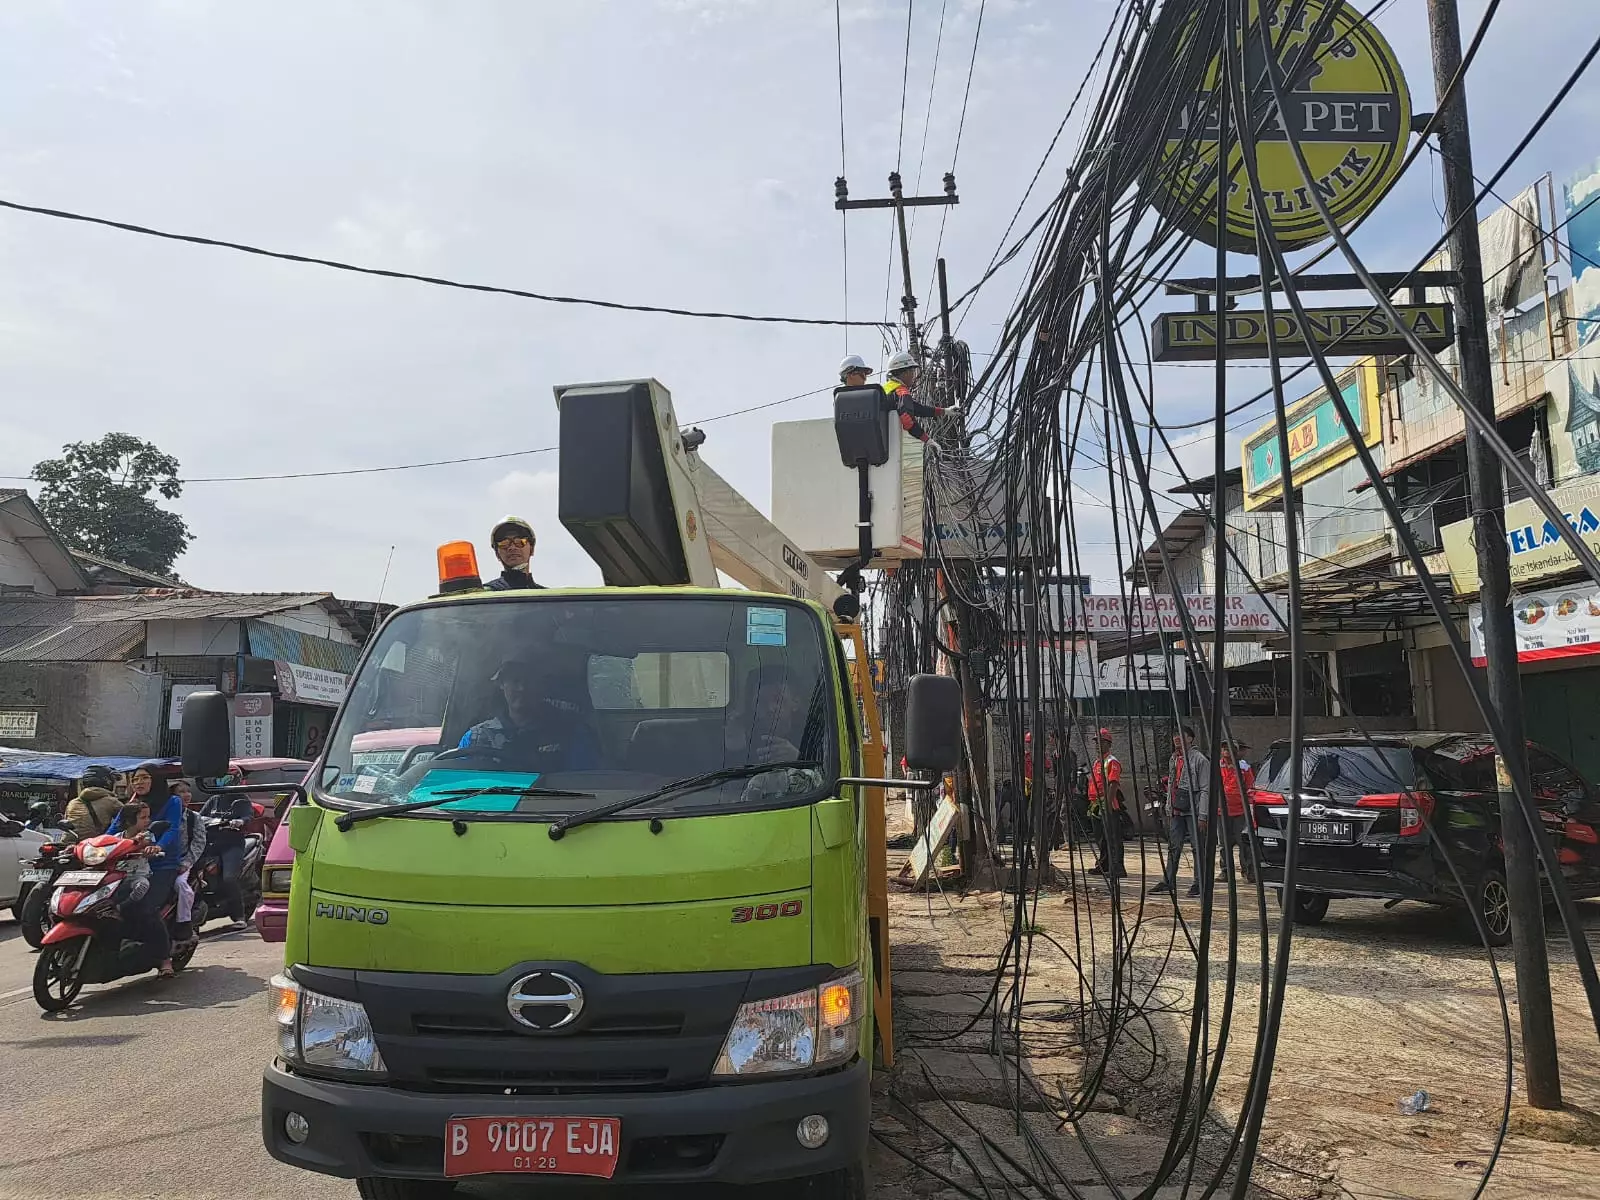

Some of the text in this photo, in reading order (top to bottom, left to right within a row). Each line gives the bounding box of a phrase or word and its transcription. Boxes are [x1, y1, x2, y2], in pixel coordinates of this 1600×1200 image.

[1302, 101, 1391, 132] PET
[1307, 823, 1350, 835] 1986 NIF
[316, 902, 388, 925] HINO
[730, 900, 802, 924] 300
[452, 1122, 613, 1156] B 9007 EJA
